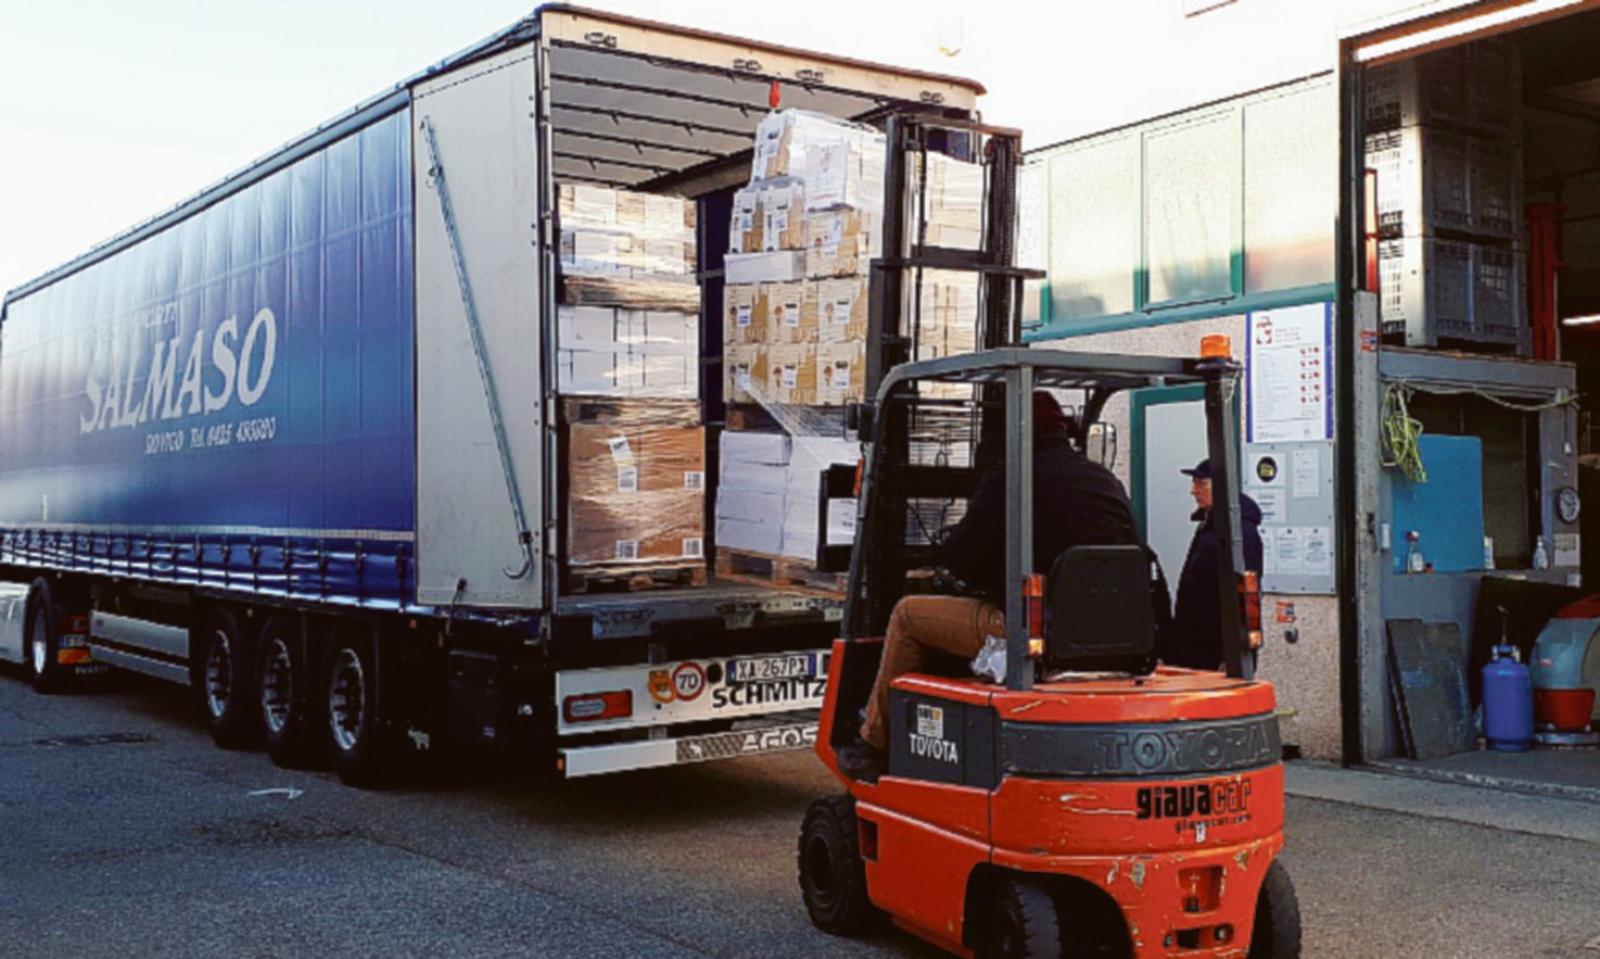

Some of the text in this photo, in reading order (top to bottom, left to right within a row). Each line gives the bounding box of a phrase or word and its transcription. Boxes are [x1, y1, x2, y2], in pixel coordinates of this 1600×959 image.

[80, 307, 277, 436] SALMASO
[678, 672, 699, 690] 70
[711, 680, 825, 709] SCHMITZ
[909, 732, 959, 765] TOYOTA
[1097, 724, 1271, 771] TOYOTA
[1136, 778, 1252, 820] giavacar
